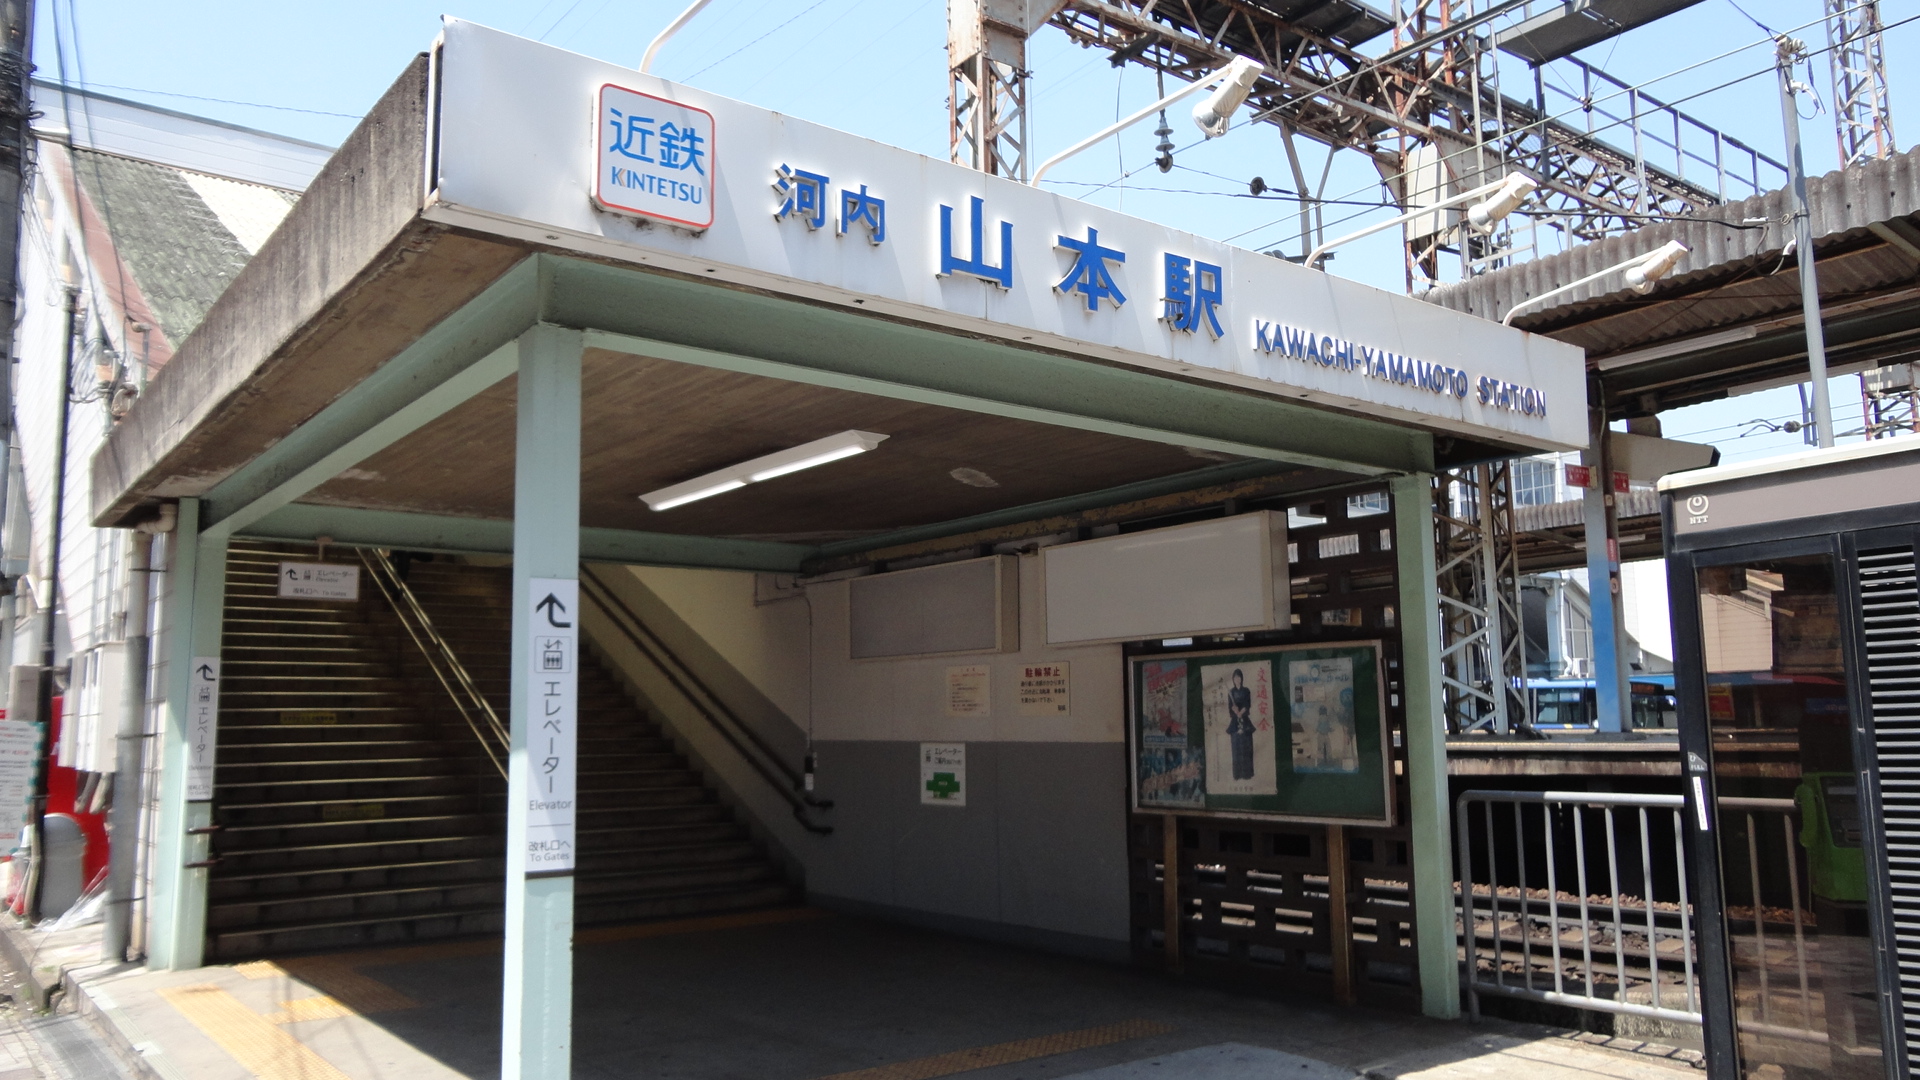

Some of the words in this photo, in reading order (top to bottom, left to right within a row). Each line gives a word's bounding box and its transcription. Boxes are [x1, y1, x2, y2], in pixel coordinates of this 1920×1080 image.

[609, 107, 705, 177] 近鉄
[610, 165, 703, 206] KINTETSU
[1254, 318, 1469, 399] KAWACHI-YAMAMOTO
[1476, 375, 1547, 417] STATION
[1689, 514, 1709, 525] NTT
[1025, 666, 1061, 678] 駐輪禁止
[1256, 667, 1270, 732] 交通安全
[196, 706, 208, 763] エレベーター
[543, 681, 562, 794] エレベーター
[529, 799, 572, 812] Elevator
[528, 839, 571, 852] 改札口へ
[530, 853, 542, 862] To
[544, 851, 569, 862] Gates
